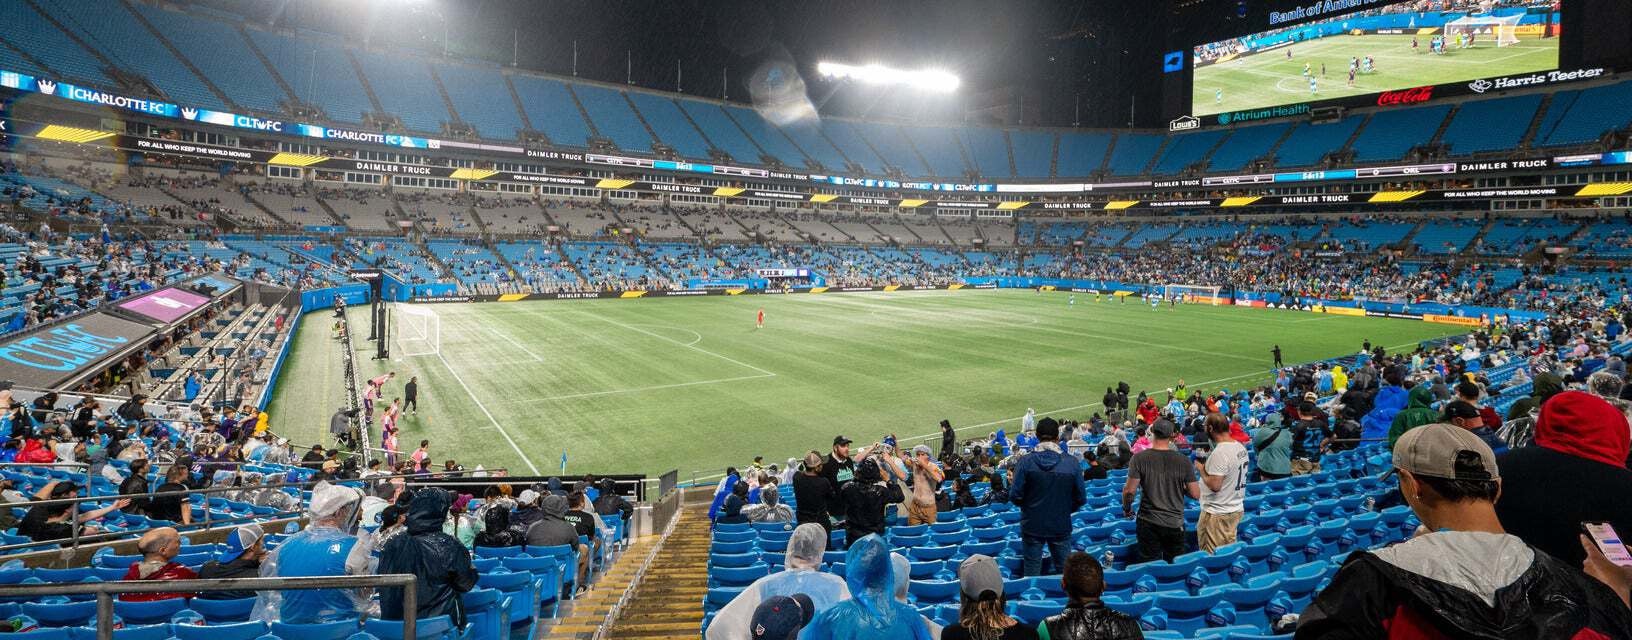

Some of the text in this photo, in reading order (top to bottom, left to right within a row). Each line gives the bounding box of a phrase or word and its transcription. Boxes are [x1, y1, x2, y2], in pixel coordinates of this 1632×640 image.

[1269, 0, 1377, 25] Bank of Amer
[1495, 67, 1603, 89] Harris Teeter
[74, 88, 164, 114] CHARLOTTE FC
[1233, 103, 1310, 122] Atrium Health
[326, 129, 397, 144] CHARLOTTE FC
[180, 145, 196, 153] KEEP
[208, 148, 228, 156] WORLD
[527, 150, 583, 161] DAIMLER TRUCK
[356, 161, 431, 175] DAIMLER TRUCK
[1461, 159, 1547, 171] DAIMLER TRUCK
[652, 184, 680, 192] DAIMLER
[1154, 180, 1180, 188] DAIMLER
[1282, 195, 1349, 204] DAIMLER TRUCK
